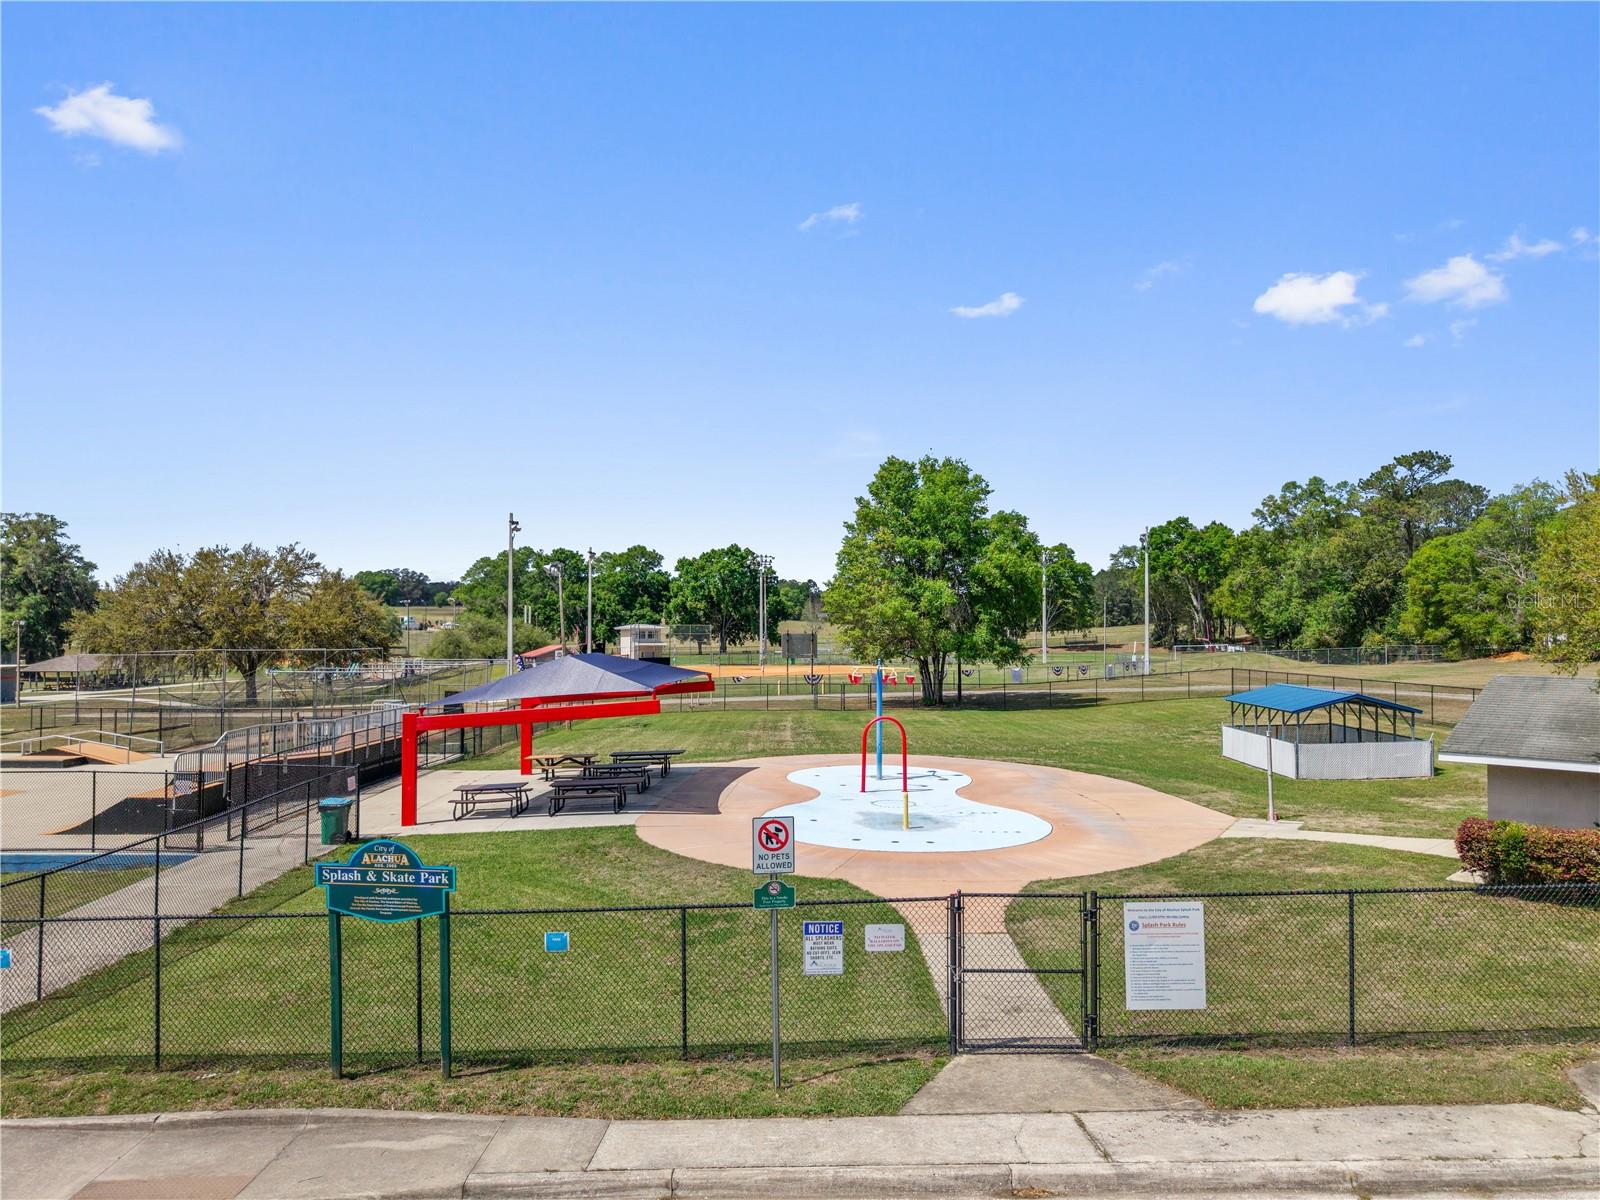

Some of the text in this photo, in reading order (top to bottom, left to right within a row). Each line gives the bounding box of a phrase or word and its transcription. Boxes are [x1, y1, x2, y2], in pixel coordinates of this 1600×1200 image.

[374, 844, 396, 856] City of
[361, 853, 410, 866] ALACHUA
[322, 868, 449, 885] Splash & Skate Park
[808, 924, 840, 934] NOTICE
